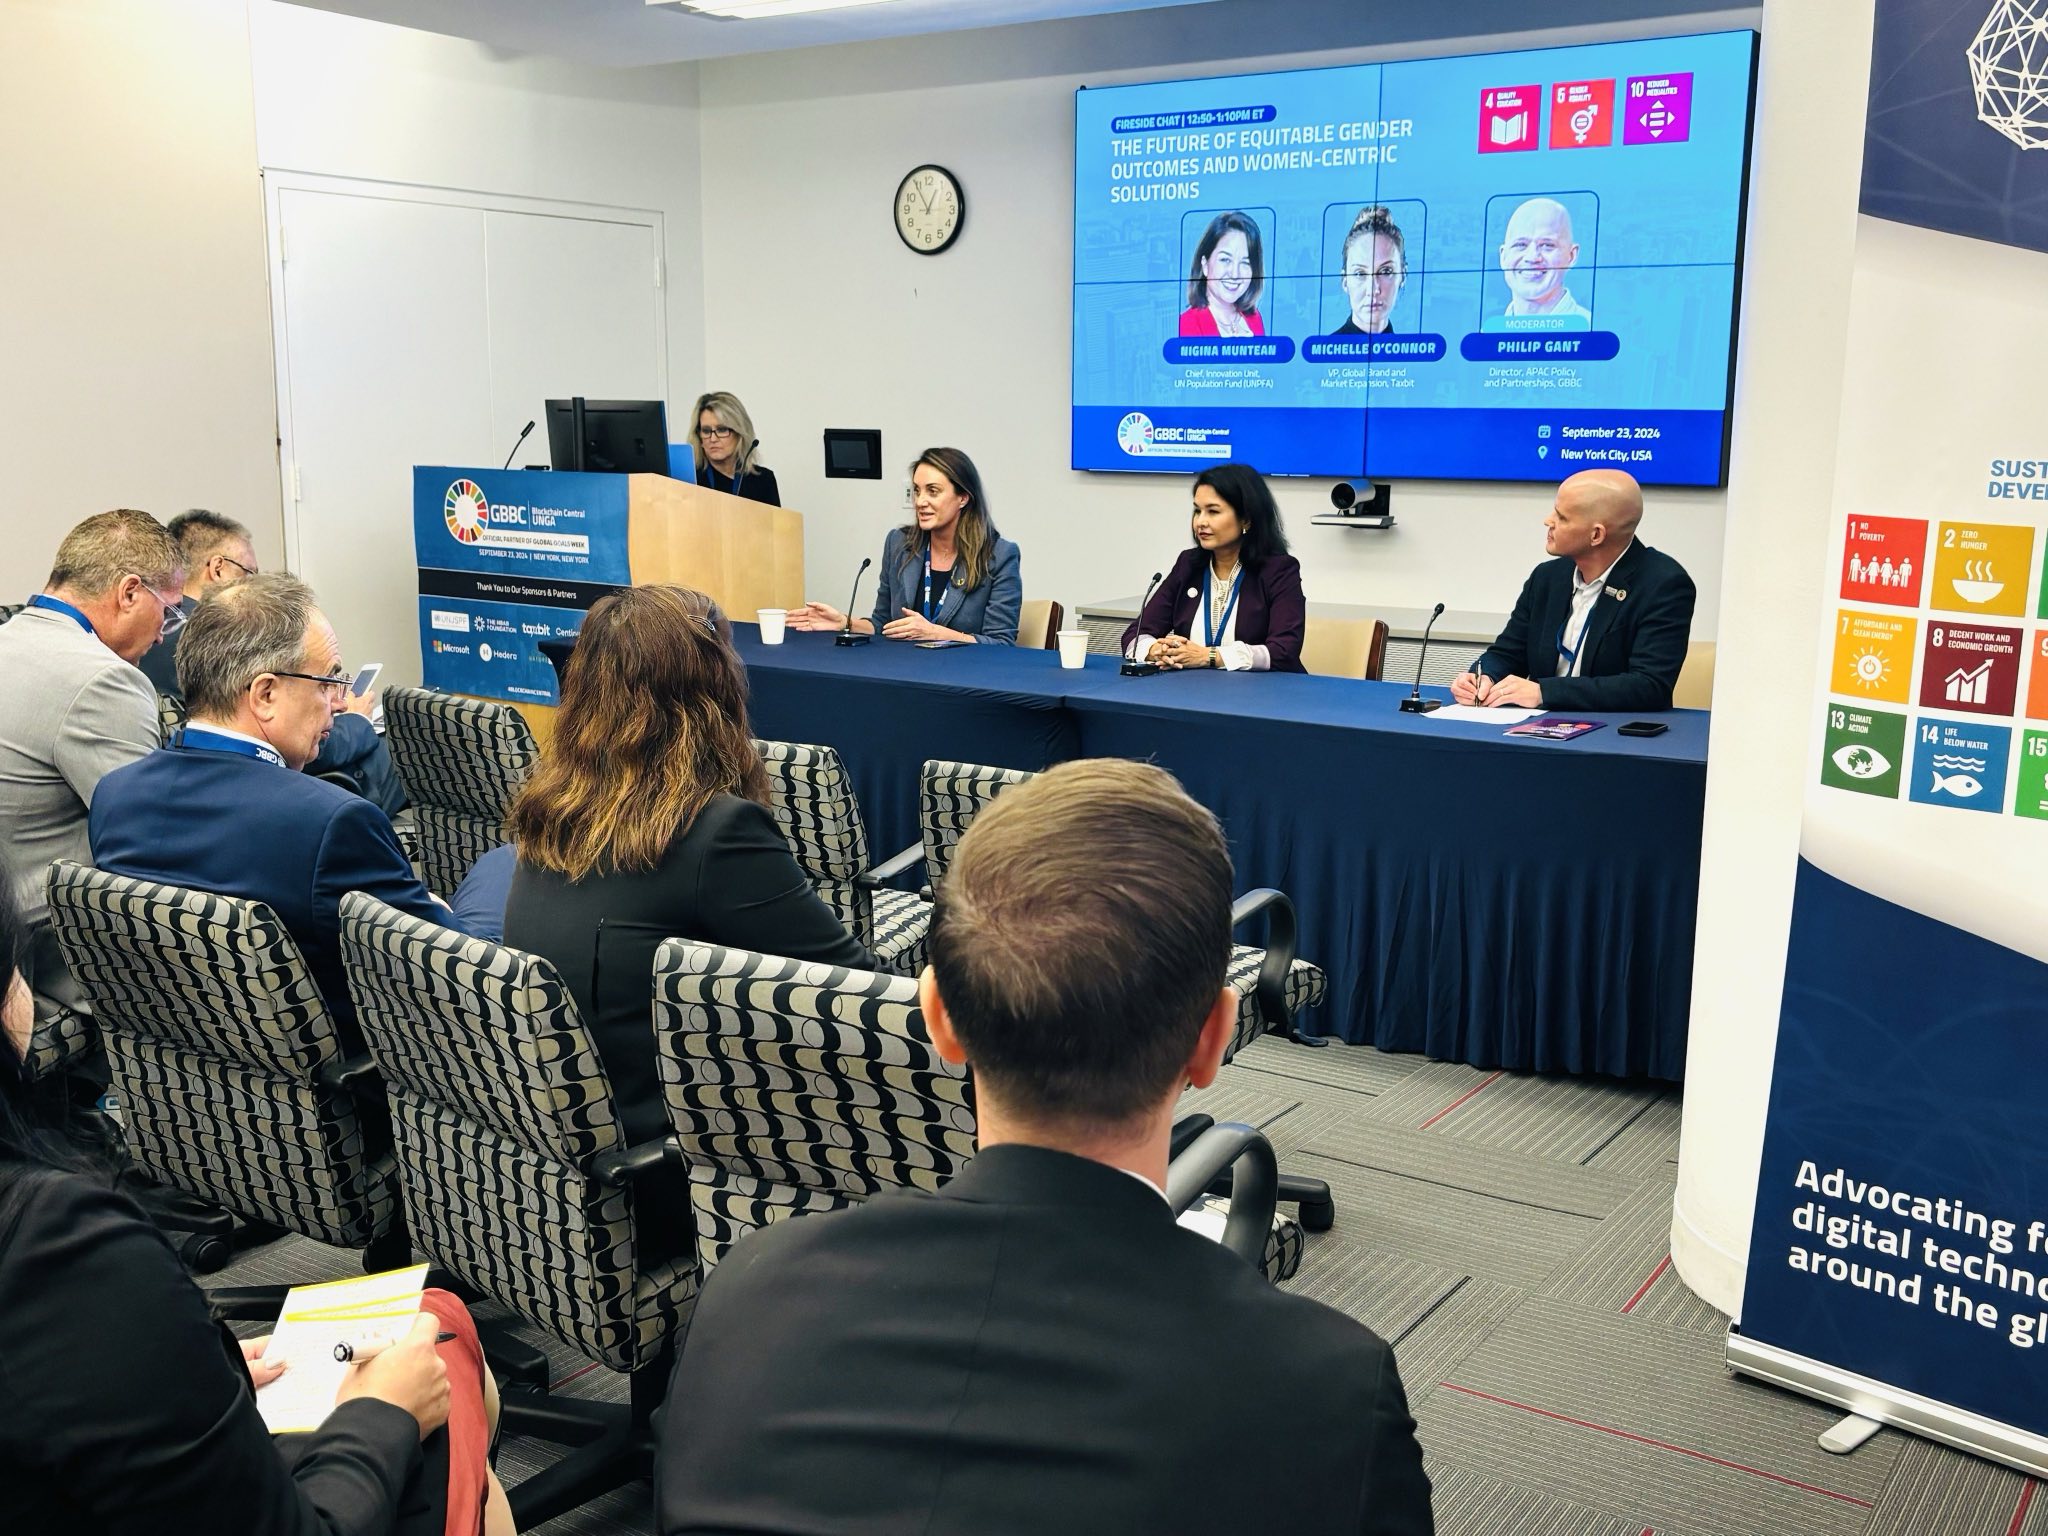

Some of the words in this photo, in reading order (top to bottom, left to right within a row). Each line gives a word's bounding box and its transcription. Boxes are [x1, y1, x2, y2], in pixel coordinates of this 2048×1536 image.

[1630, 82, 1644, 98] 10
[1485, 93, 1493, 108] 4
[1116, 116, 1155, 130] FIRESIDE
[1156, 115, 1180, 127] CHAT
[1252, 108, 1264, 120] ET
[1112, 138, 1142, 156] THE
[1146, 134, 1209, 154] FUTURE
[1214, 132, 1236, 150] OF
[1240, 125, 1334, 149] EQUITABLE
[1339, 119, 1413, 141] GENDER
[1111, 158, 1199, 180] OUTCOMES
[1203, 155, 1239, 174] AND
[1243, 144, 1398, 172] WOMEN-CENTRIC
[925, 176, 934, 186] 12
[906, 193, 916, 203] 10
[946, 192, 952, 201] 2
[1111, 182, 1200, 203] SOLUTIONS
[904, 205, 910, 214] 9
[949, 205, 955, 215] 3
[908, 218, 914, 227] 8
[945, 219, 951, 227] 4
[916, 229, 921, 238] 7
[925, 234, 932, 243] 6
[937, 230, 943, 238] 5
[1505, 320, 1564, 329] MODERATOR
[1180, 345, 1218, 357] NIGINA
[1222, 345, 1277, 356] MUNTEAN
[1311, 344, 1369, 355] MICHELLE
[1373, 342, 1436, 354] O'CONNOR
[1498, 341, 1541, 352] PHILIP
[1545, 340, 1580, 352] GANT
[1206, 369, 1242, 377] Innovation
[1342, 368, 1365, 377] Global
[1391, 368, 1406, 376] and
[1490, 368, 1524, 376] Director,
[1526, 367, 1549, 376] APAC
[1551, 367, 1576, 377] Policy
[1187, 380, 1223, 389] Population
[1244, 380, 1273, 388] (UNPFA)
[1321, 379, 1347, 387] Market
[1392, 379, 1414, 387] Taxbit
[1484, 379, 1499, 387] and
[1501, 379, 1556, 388] Partnerships,
[1558, 378, 1582, 387] GBBC
[1155, 428, 1184, 441] GBBC
[1562, 426, 1615, 439] September
[1616, 428, 1632, 439] 23,
[1634, 428, 1661, 439] 2024
[1561, 449, 1583, 460] New
[1585, 450, 1606, 460] York
[1608, 450, 1629, 462] City,
[1631, 450, 1652, 461] USA
[1991, 460, 2048, 478] SUST
[490, 504, 527, 524] GBBC
[531, 507, 562, 516] Blockchain
[563, 509, 585, 518] Central
[532, 515, 556, 527] UNGA
[1860, 522, 1868, 530] NO
[1850, 521, 1856, 539] 1
[1961, 530, 1978, 539] ZERO
[533, 538, 553, 546] GLOBAL
[1859, 532, 1885, 542] POVERTY
[1944, 529, 1954, 548] 2
[1960, 541, 1988, 551] HUNGER
[575, 556, 589, 564] YORK
[477, 582, 492, 591] Thank
[493, 584, 504, 592] You
[511, 586, 521, 594] Our
[522, 587, 546, 597] Sponsors
[553, 590, 576, 599] Partners
[1842, 617, 1849, 634] 7
[1932, 628, 1943, 647] 8
[1949, 629, 1973, 640] DECENT
[1974, 632, 1994, 642] WORK
[1996, 634, 2010, 642] AND
[443, 643, 470, 654] Microsoft
[1948, 640, 1982, 650] ECONOMIC
[1984, 643, 2013, 654] GROWTH
[493, 650, 518, 660] Hedera
[1831, 710, 1844, 730] 13
[1849, 714, 1872, 724] CLIMATE
[1848, 724, 1869, 734] ACTION
[1922, 725, 1938, 744] 14
[1945, 728, 1958, 736] LIFE
[1944, 738, 1966, 747] BELOW
[1966, 740, 1988, 750] WATER
[2028, 737, 2047, 757] 15
[1795, 1160, 2016, 1254] Advocating
[2027, 1221, 2048, 1255] f
[1792, 1202, 1911, 1259] digital
[1788, 1246, 1922, 1305] around
[1934, 1283, 1998, 1329] the
[2008, 1311, 2048, 1348] gl
